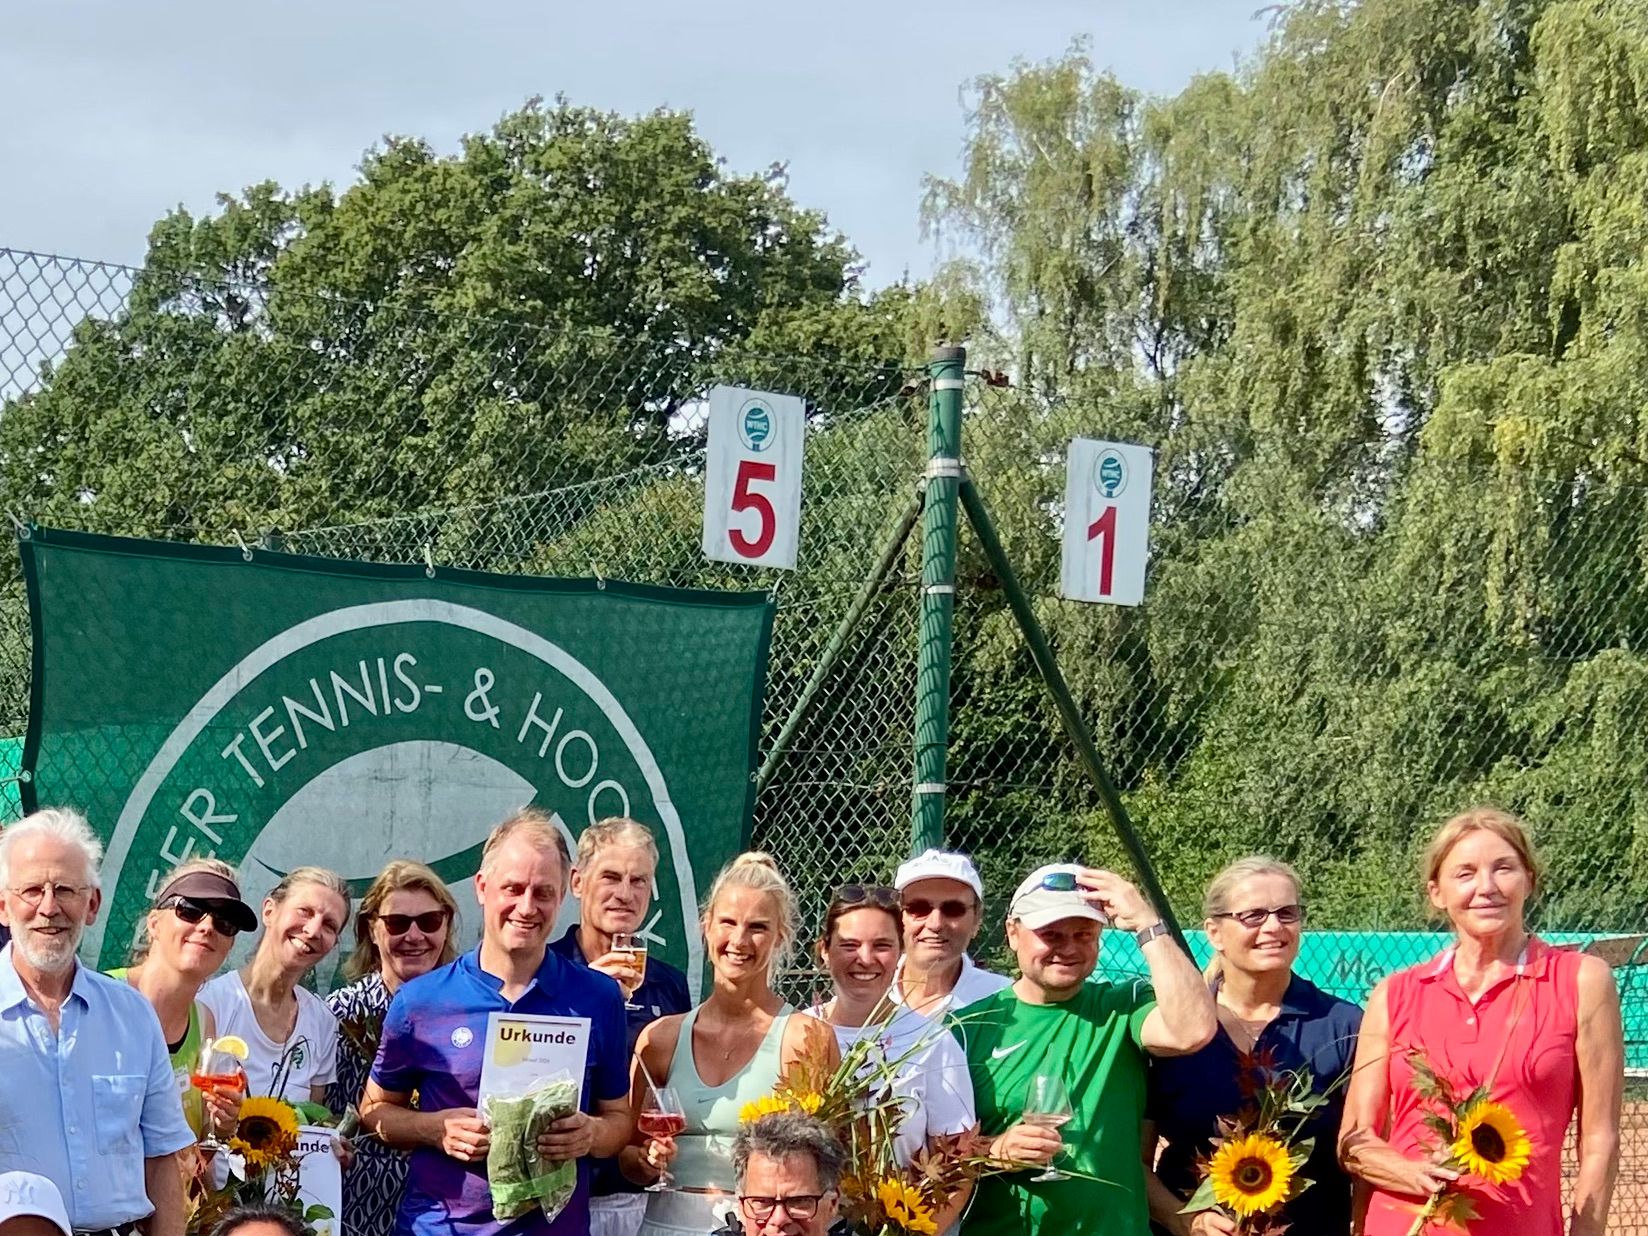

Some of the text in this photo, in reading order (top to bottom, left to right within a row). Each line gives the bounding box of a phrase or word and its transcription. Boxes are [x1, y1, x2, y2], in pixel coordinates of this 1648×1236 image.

[728, 460, 776, 559] 5
[1087, 505, 1117, 596] 1
[221, 652, 443, 788] TENNIS-
[464, 667, 500, 729] &
[517, 692, 666, 947] HOCY
[500, 1027, 577, 1046] Urkunde
